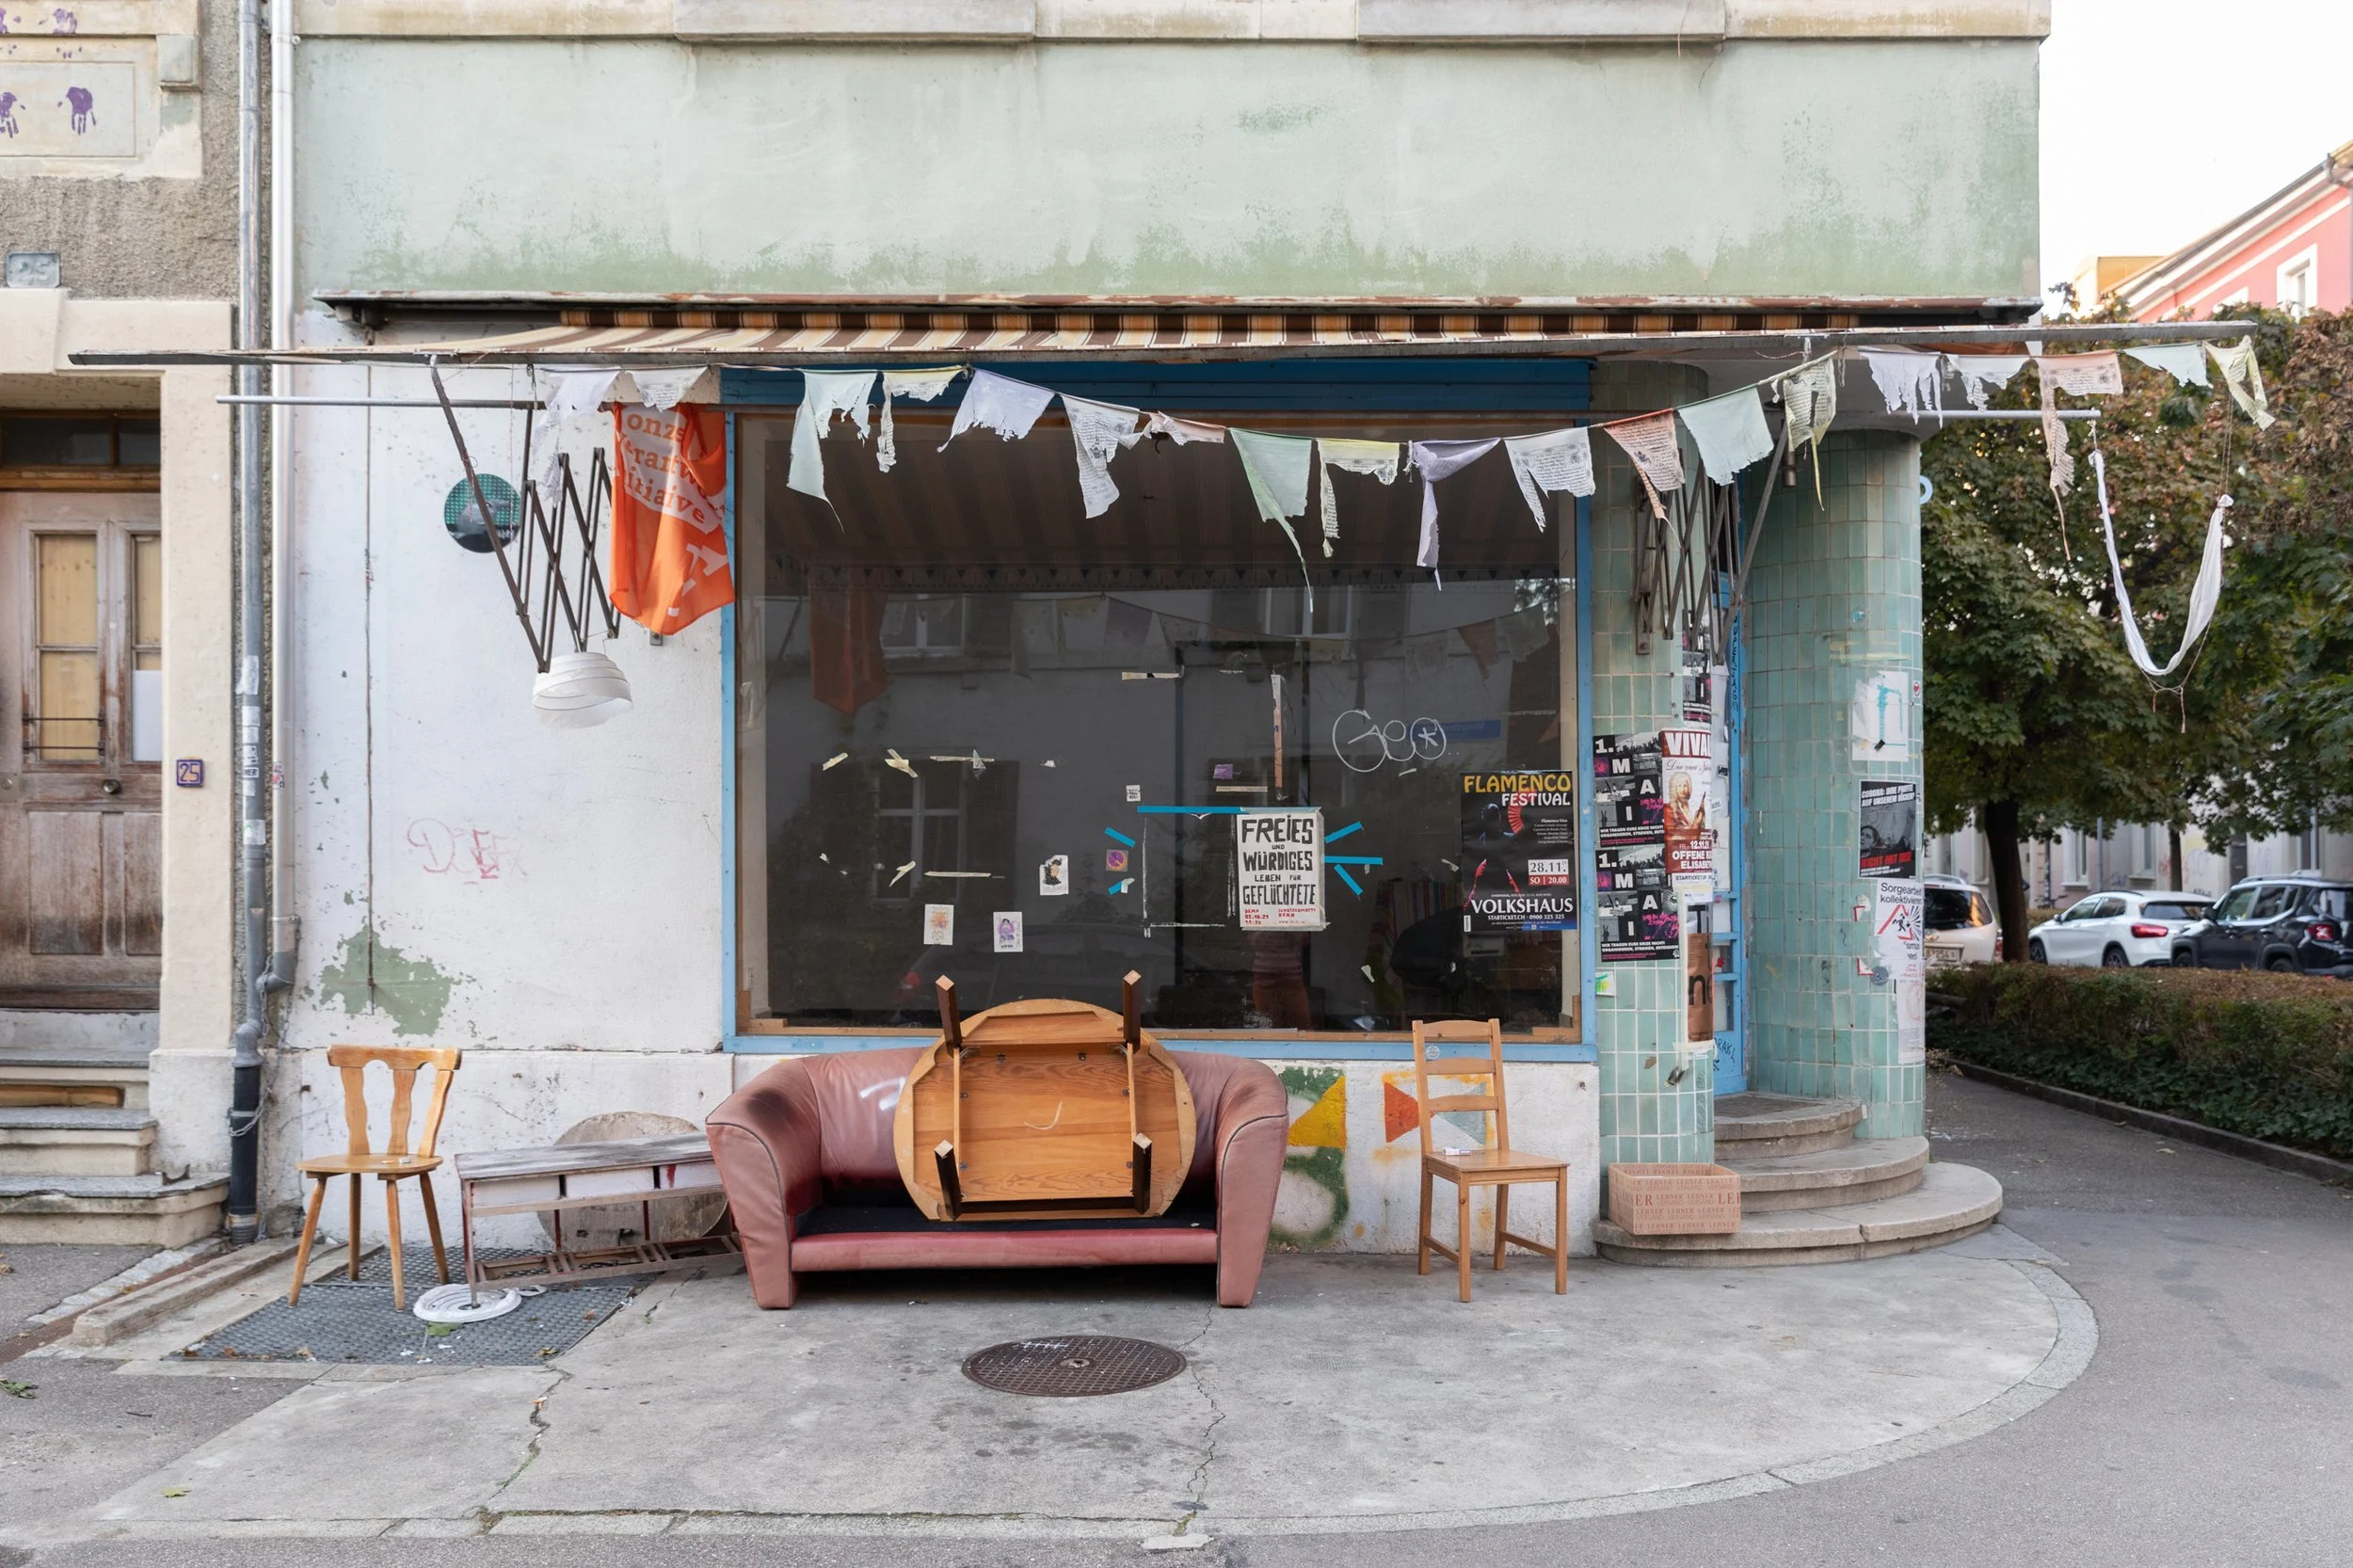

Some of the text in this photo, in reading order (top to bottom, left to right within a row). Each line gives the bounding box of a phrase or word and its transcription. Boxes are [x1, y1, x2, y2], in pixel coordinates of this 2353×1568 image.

[1595, 738, 1614, 753] 1.
[180, 762, 199, 782] 25
[1611, 758, 1631, 774] M
[1464, 774, 1571, 793] FLAMENCO
[1640, 779, 1656, 794] A
[1501, 792, 1571, 807] FESTIVAL
[1625, 806, 1633, 821] I
[1242, 851, 1313, 872] WÜRDIGES
[1598, 852, 1617, 868] 1.
[1672, 850, 1705, 860] OFFENE
[1255, 873, 1281, 882] LEBEN
[1529, 876, 1541, 885] SO
[1615, 872, 1634, 888] M
[1242, 884, 1316, 905] GEFLÜCHTETE
[1642, 894, 1658, 910] A
[1470, 898, 1574, 914] VOLKSHAUS
[1627, 920, 1634, 936] I
